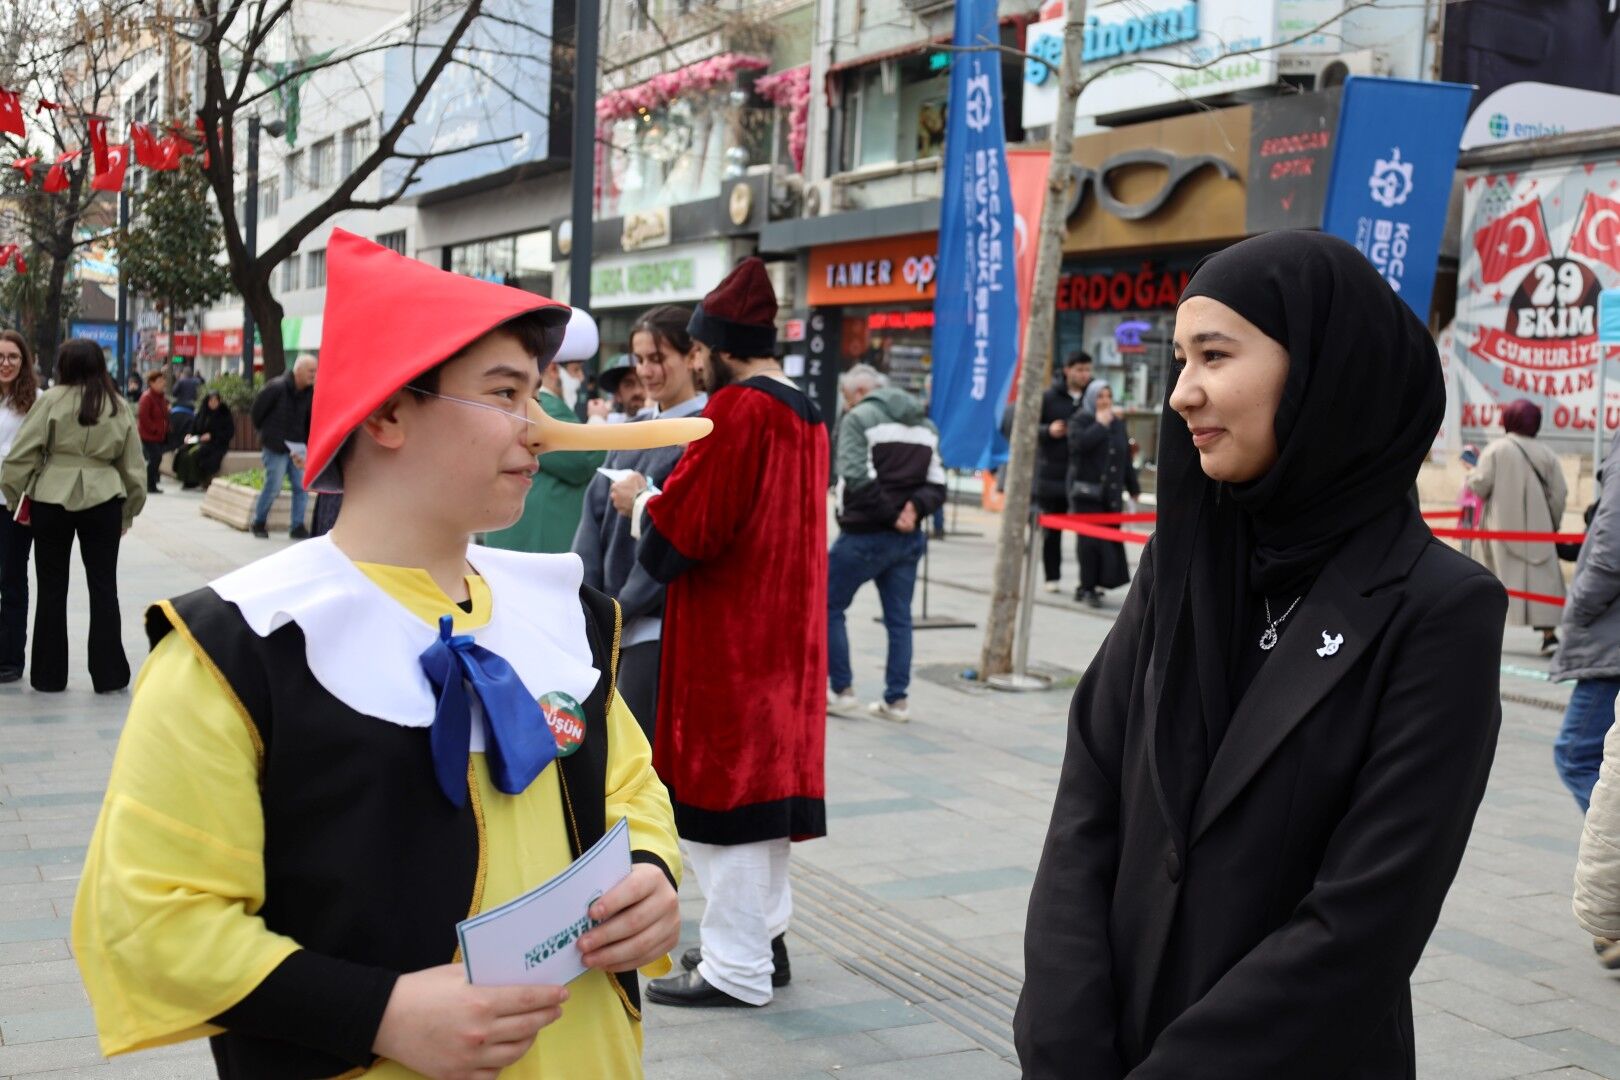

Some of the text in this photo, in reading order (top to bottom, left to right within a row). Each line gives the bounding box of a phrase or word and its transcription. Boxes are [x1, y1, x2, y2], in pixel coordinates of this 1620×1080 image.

[1024, 3, 1198, 86] geinomi
[826, 254, 938, 293] TAMER op
[1530, 261, 1585, 307] 29
[1515, 304, 1595, 339] EKİM
[1494, 336, 1611, 367] CUMHURİYE
